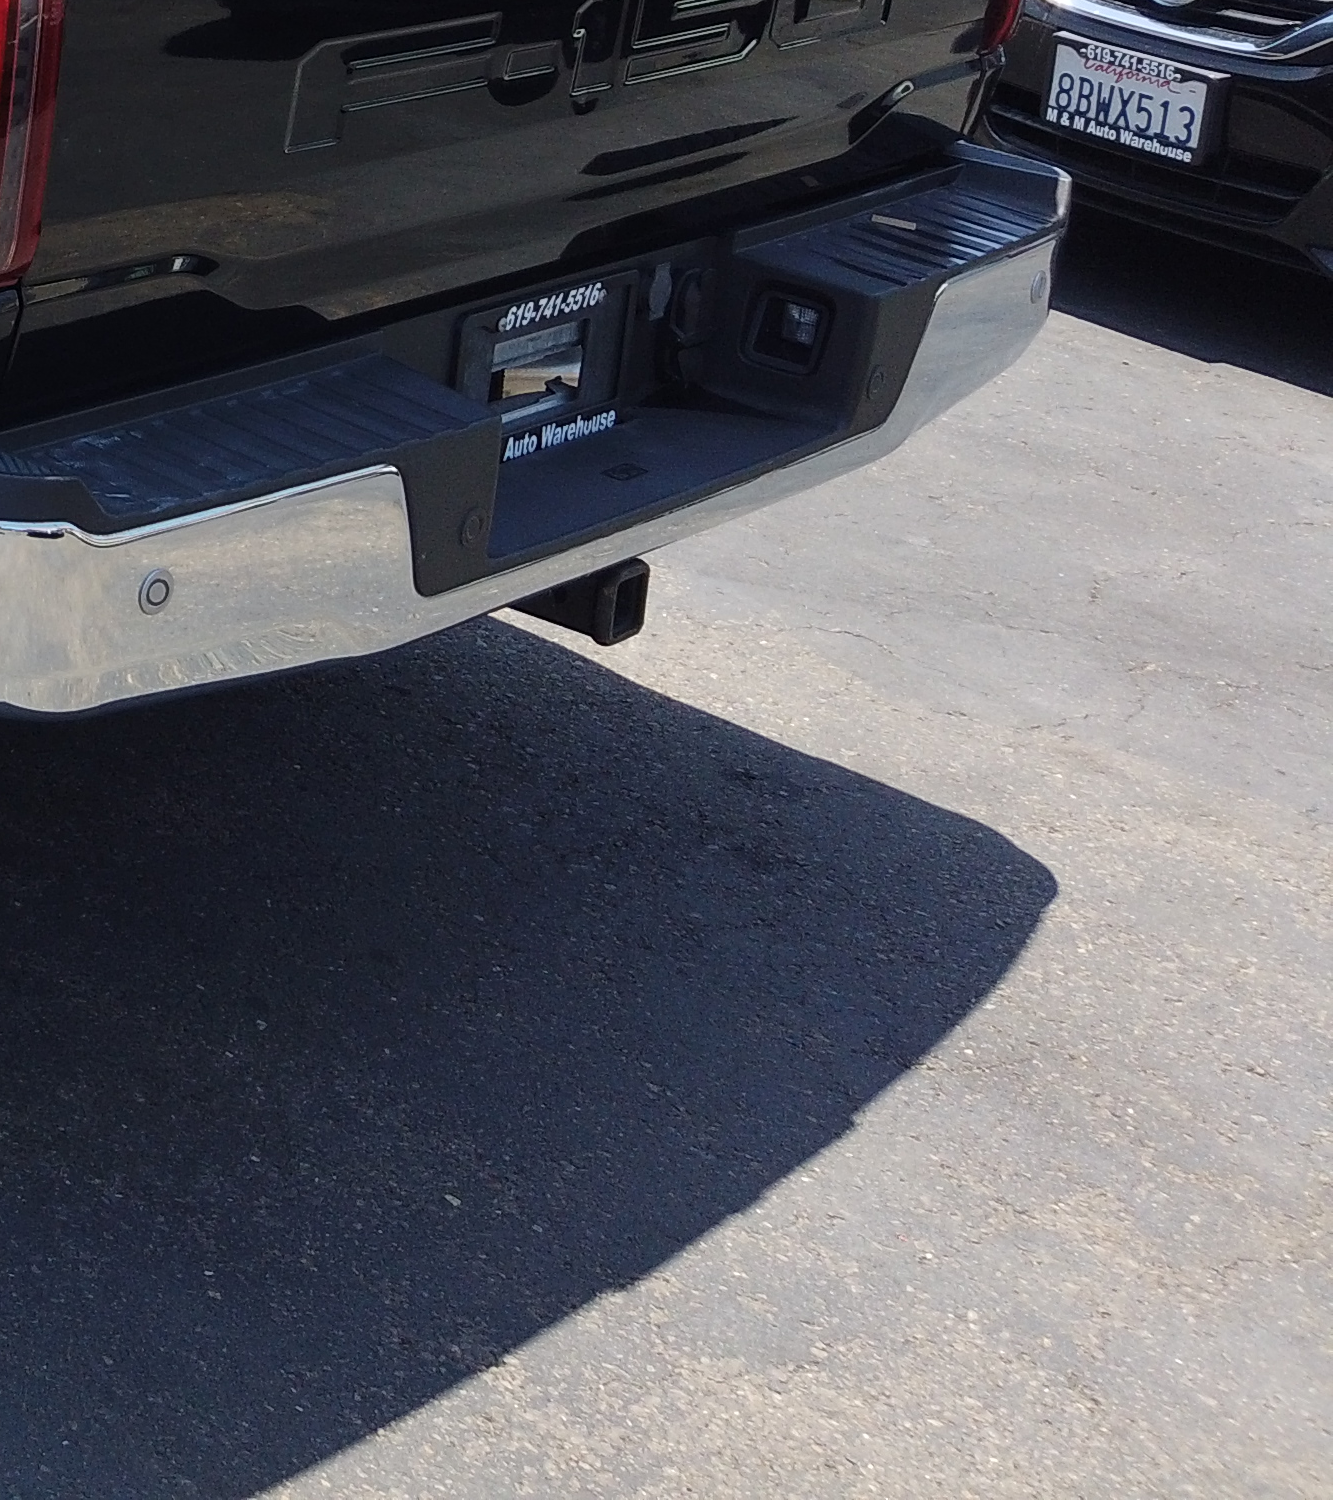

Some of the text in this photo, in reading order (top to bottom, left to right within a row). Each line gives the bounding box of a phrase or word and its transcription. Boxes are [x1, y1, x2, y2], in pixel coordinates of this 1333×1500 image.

[1086, 44, 1176, 80] 619-741-5516
[1046, 107, 1193, 163] M & M Auto Warehouse
[1055, 72, 1196, 146] 8BWX513
[505, 282, 602, 332] 619-741-5516
[502, 409, 617, 462] Auto Warehouse
